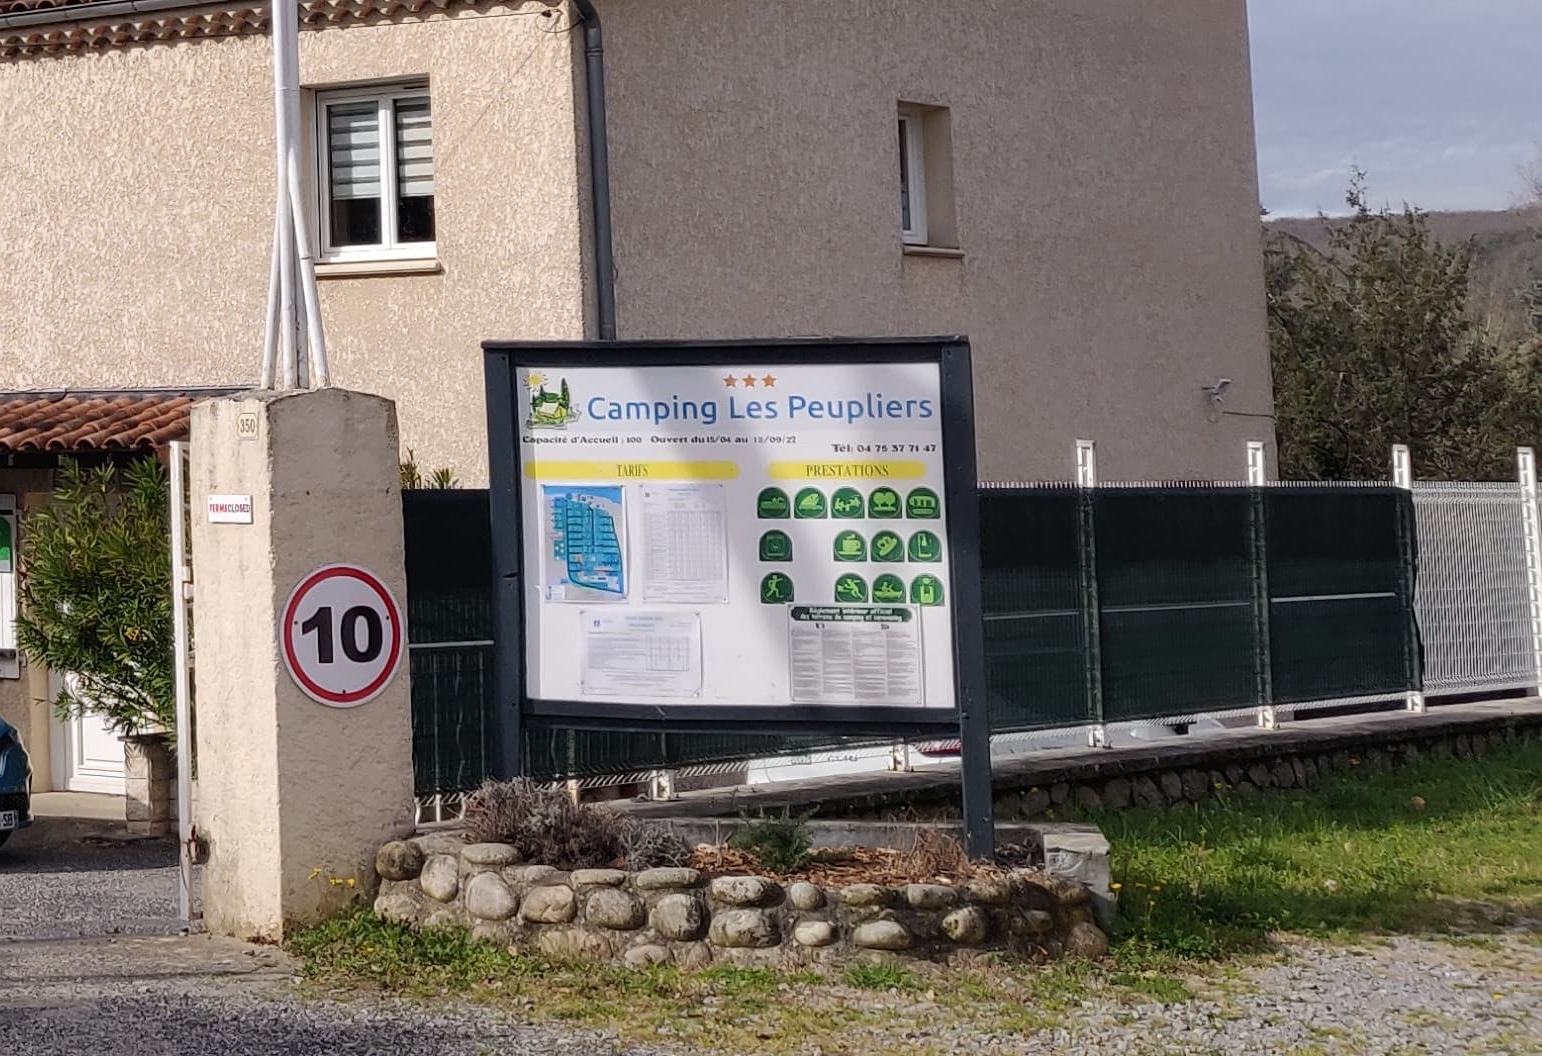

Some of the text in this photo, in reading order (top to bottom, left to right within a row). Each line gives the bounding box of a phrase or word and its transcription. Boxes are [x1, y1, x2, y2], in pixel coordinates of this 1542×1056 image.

[587, 394, 933, 425] Camping Les Peupliers
[240, 418, 255, 433] 350
[522, 434, 568, 445] Capacité
[571, 434, 618, 444] d'Accueil
[626, 436, 642, 444] 100
[650, 435, 688, 444] Ouvert
[691, 435, 705, 444] du
[735, 436, 748, 444] au
[857, 444, 871, 453] 04
[875, 444, 888, 453] 75
[891, 444, 905, 453] 37
[909, 444, 919, 453] 71
[923, 444, 936, 453] 47
[616, 463, 649, 477] TARIFS
[806, 463, 889, 477] PRESTATIONS
[227, 503, 251, 513] CLOSED
[301, 605, 384, 664] 10
